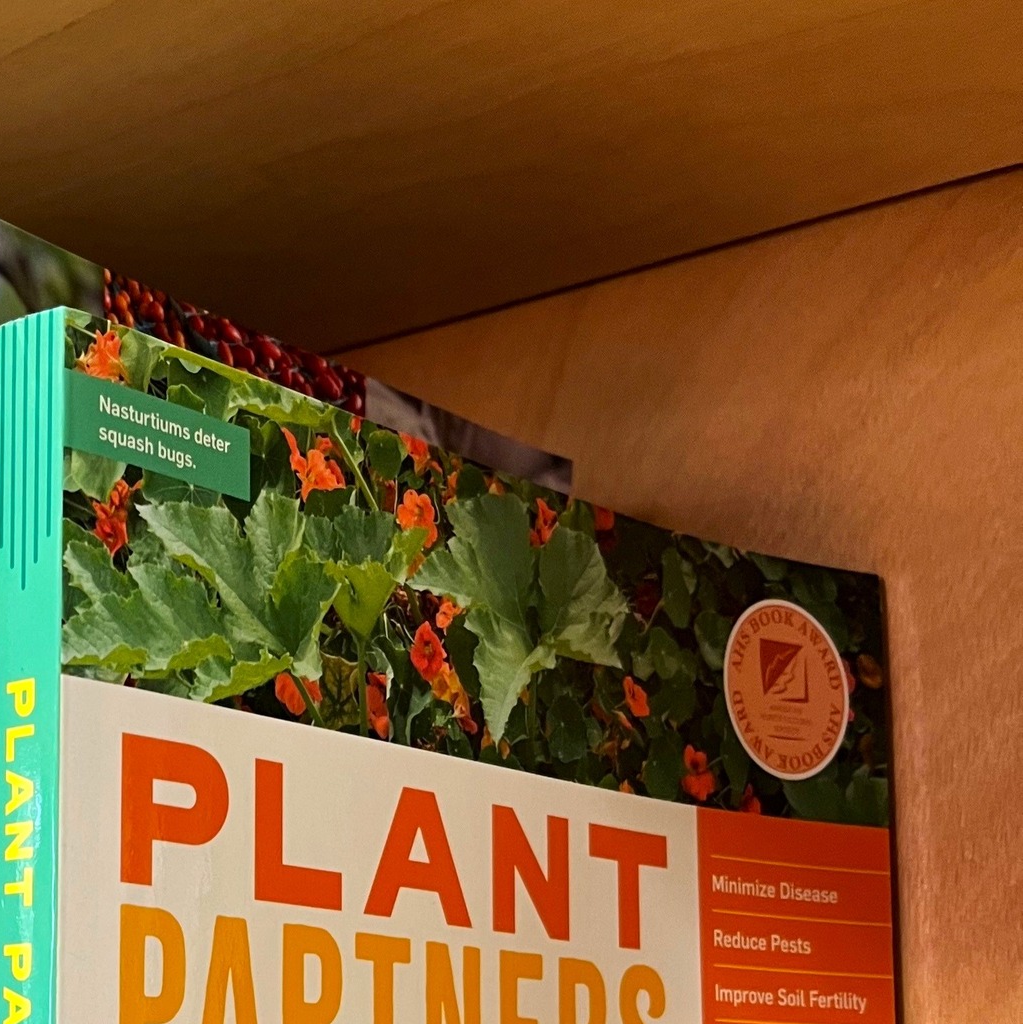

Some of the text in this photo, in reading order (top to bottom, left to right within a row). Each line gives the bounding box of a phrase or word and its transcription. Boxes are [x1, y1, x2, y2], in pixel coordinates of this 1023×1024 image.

[98, 394, 231, 454] Nasturtiums deter
[98, 425, 197, 470] squash bugs.
[749, 608, 795, 634] BOOK
[797, 620, 842, 692] AWARD
[4, 677, 36, 908] PLANT
[120, 732, 668, 950] PLANT
[712, 874, 838, 904] Minimize Disease
[713, 929, 811, 954] Reduce Pests
[714, 984, 867, 1014] Improve Soil Fertility
